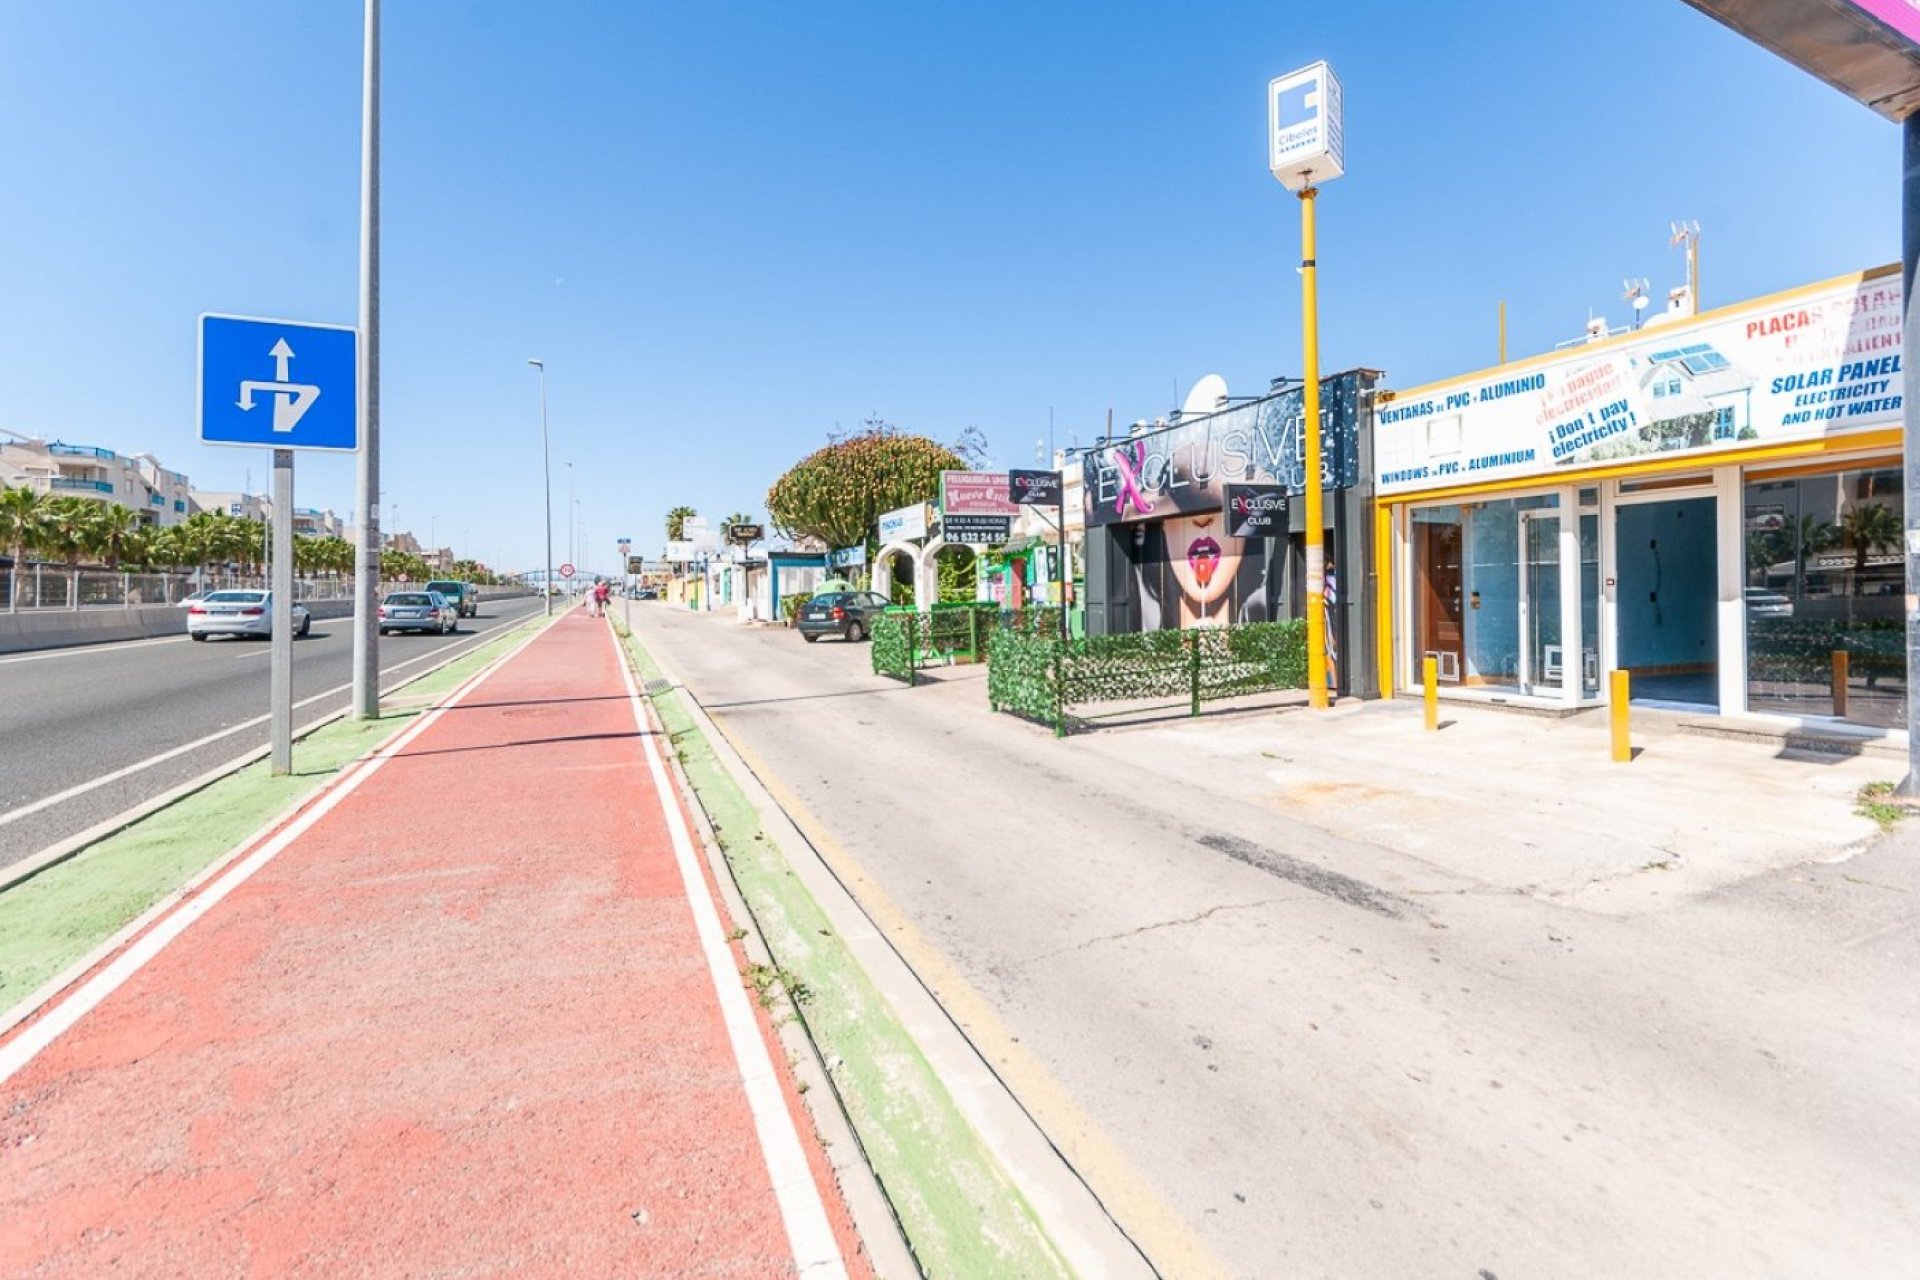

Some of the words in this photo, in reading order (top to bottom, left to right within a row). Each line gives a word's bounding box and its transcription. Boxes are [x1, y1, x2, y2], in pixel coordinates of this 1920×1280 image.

[1278, 126, 1318, 146] Cibeles
[1771, 367, 1835, 394] SOLAR
[1837, 354, 1902, 383] PANEL
[1380, 400, 1434, 426] VENTANAS
[1447, 391, 1470, 411] PVC
[1480, 373, 1545, 402] ALUMINIO
[1794, 379, 1891, 407] ELECTRICITY
[1600, 398, 1630, 421] pay
[1781, 410, 1811, 426] AND
[1814, 404, 1846, 421] HOT
[1847, 395, 1903, 416] WATER
[1098, 407, 1327, 516] EXCLUSIVE
[1381, 467, 1429, 485] WINDOWS
[1468, 448, 1536, 471] ALUMINIUM
[1015, 475, 1059, 490] EXCLUSIVE
[1231, 495, 1286, 515] EXCLUSIVE
[1247, 516, 1272, 526] CLUB
[945, 532, 959, 541] 96
